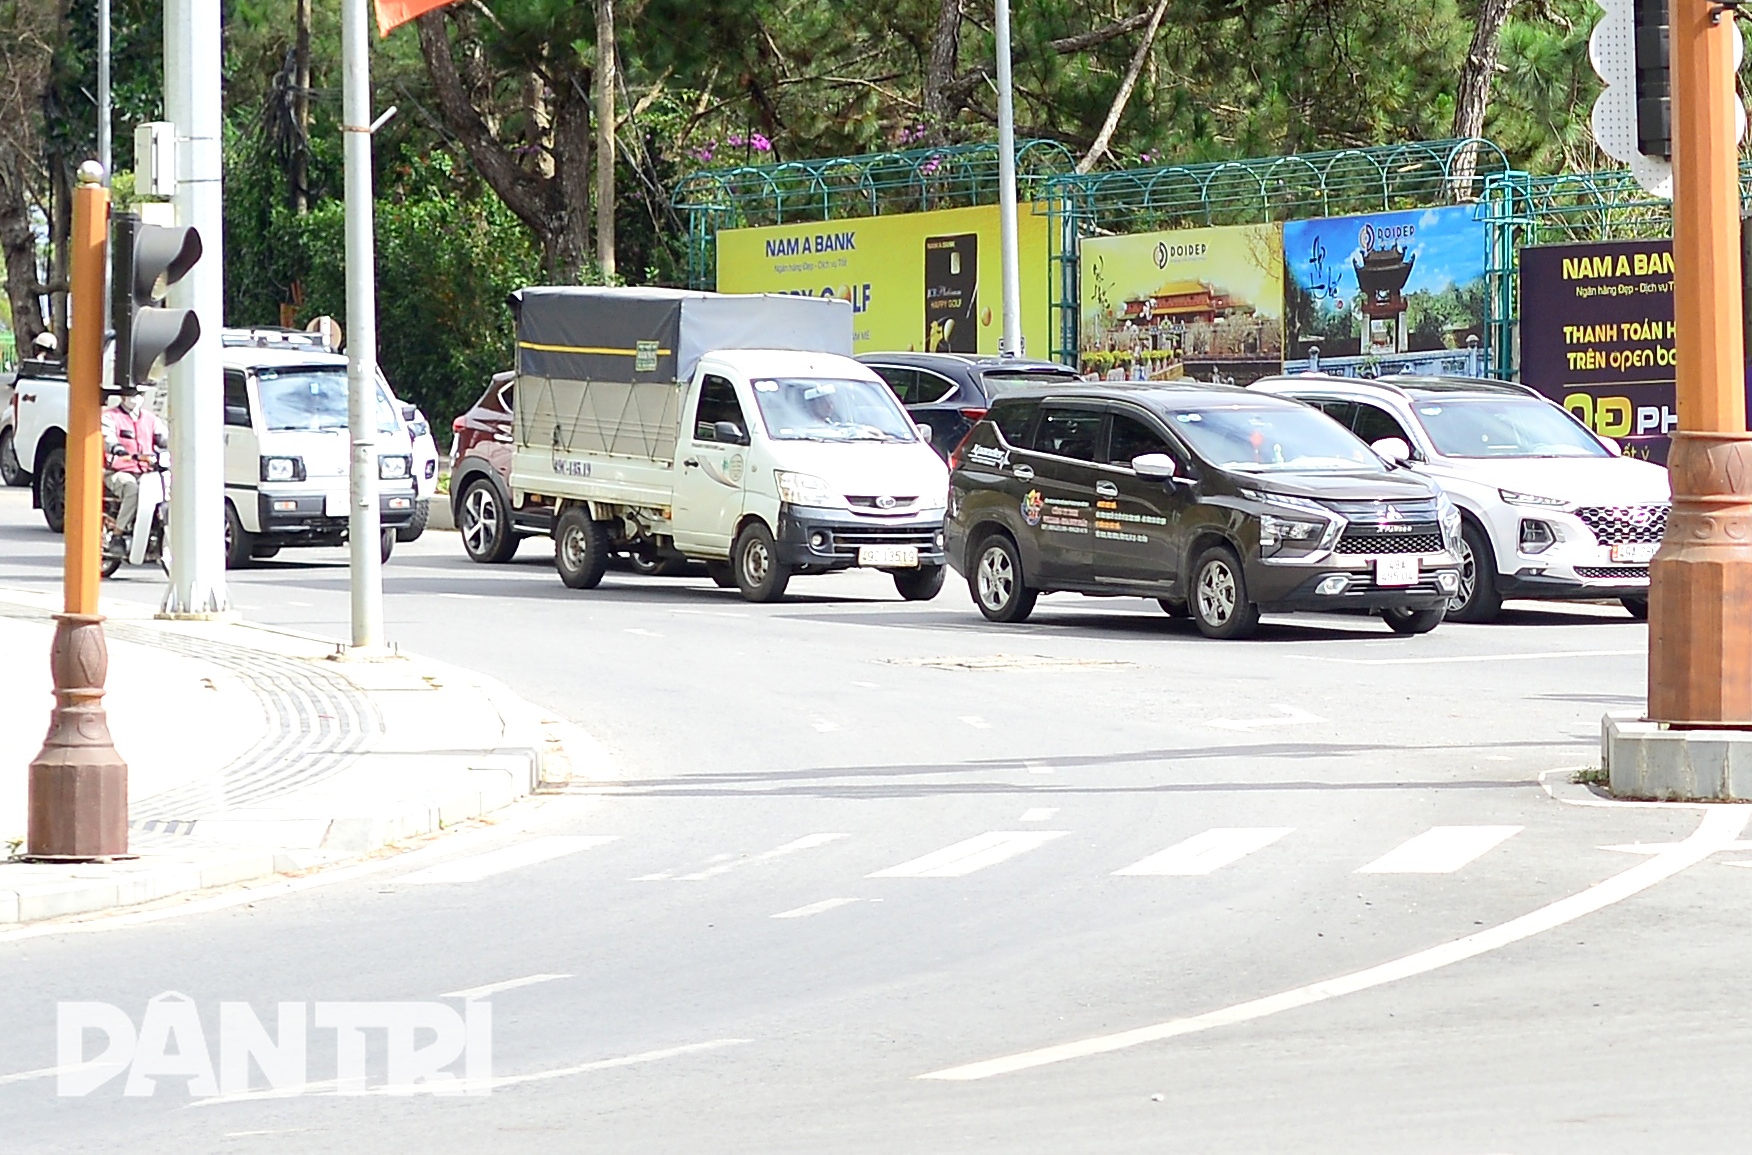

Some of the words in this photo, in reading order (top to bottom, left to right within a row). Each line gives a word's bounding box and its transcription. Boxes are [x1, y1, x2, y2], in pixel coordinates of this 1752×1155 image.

[765, 238, 799, 258] NAM
[802, 236, 811, 254] A
[815, 231, 856, 253] BANK
[1562, 255, 1612, 280] NAM
[1615, 254, 1631, 277] A
[1634, 251, 1675, 276] BAN
[1563, 323, 1617, 345] THANH
[1620, 317, 1663, 342] TOÁN
[1566, 347, 1606, 371] TRÊN
[1636, 405, 1679, 435] PH
